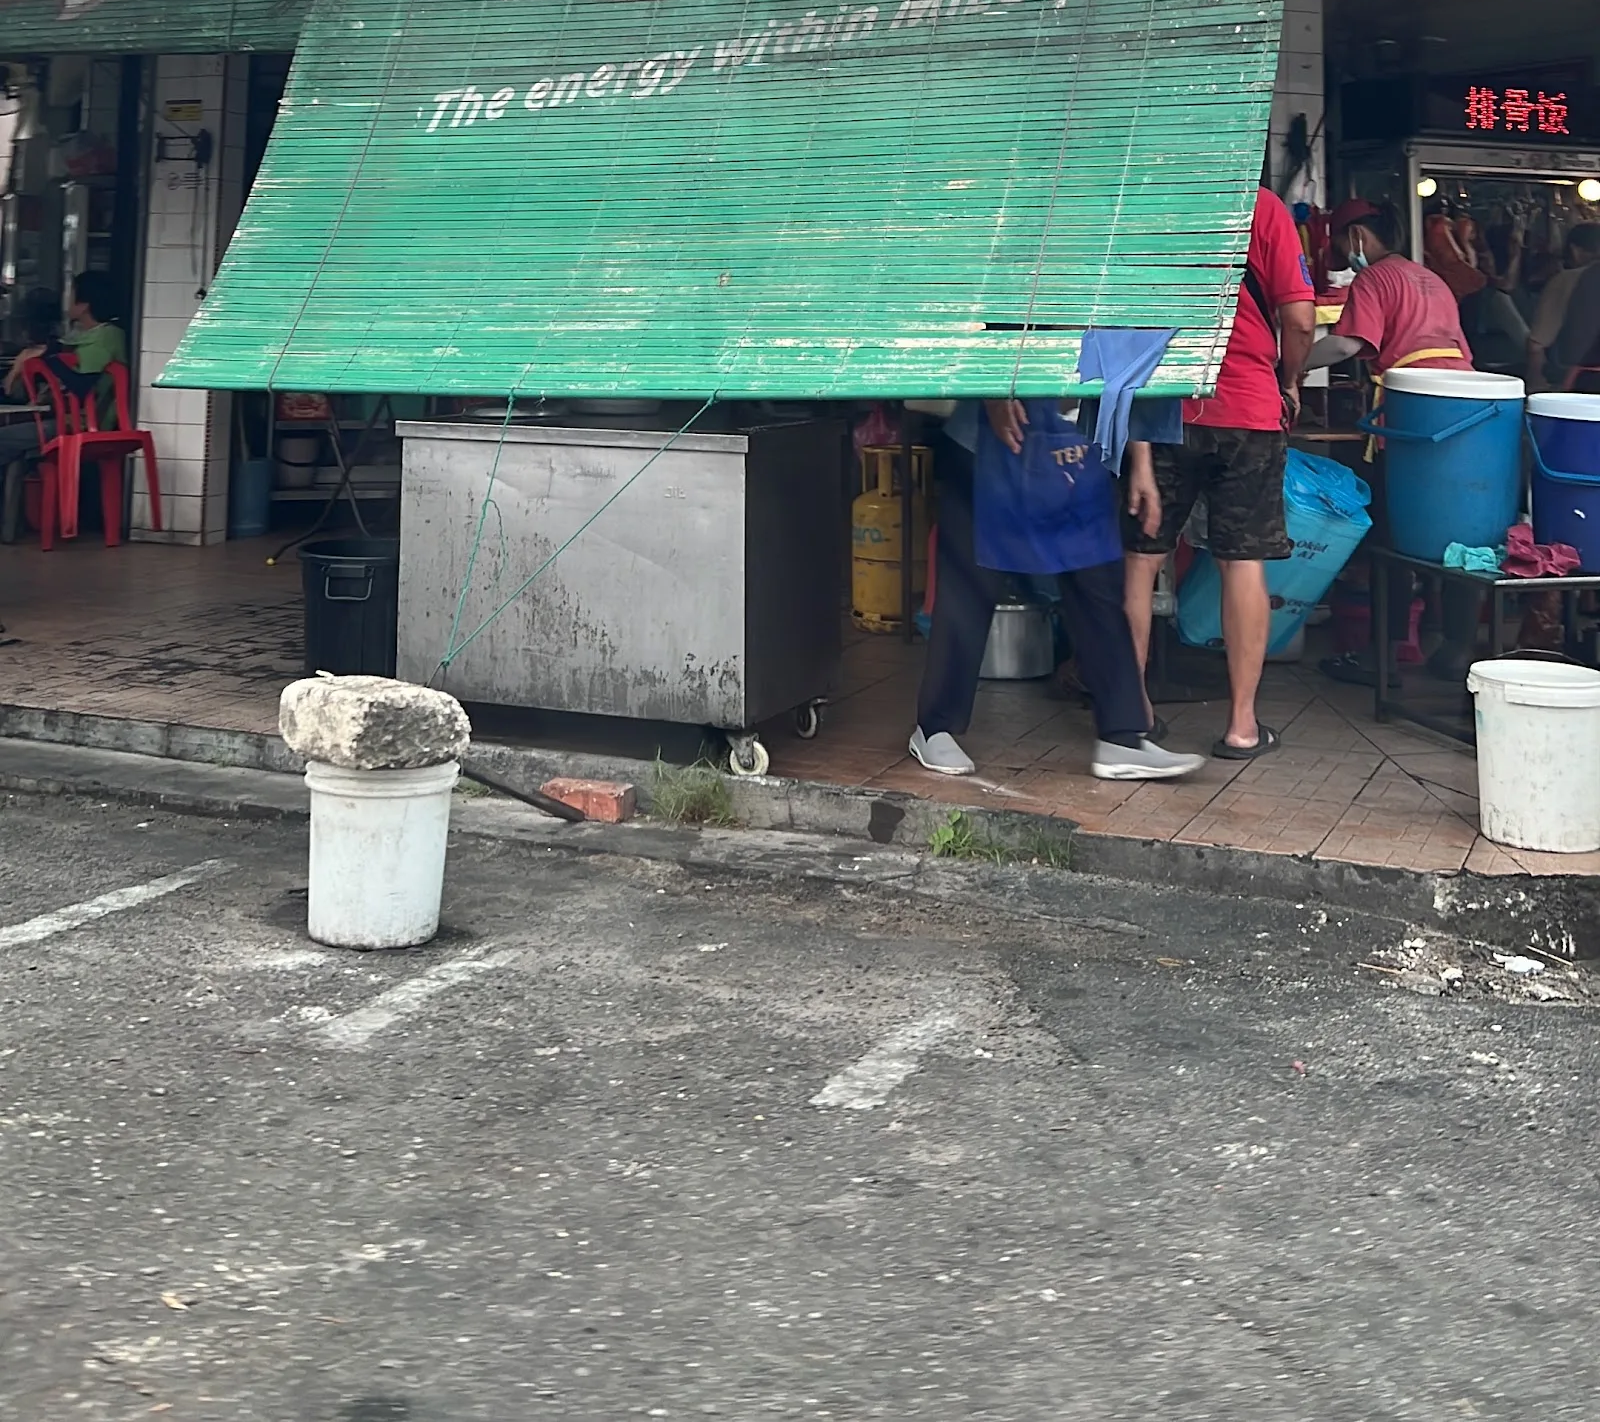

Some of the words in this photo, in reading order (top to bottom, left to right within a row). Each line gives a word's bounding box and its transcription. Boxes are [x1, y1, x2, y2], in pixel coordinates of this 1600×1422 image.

[425, 85, 515, 133] The
[524, 45, 703, 112] energy
[712, 3, 880, 75] within
